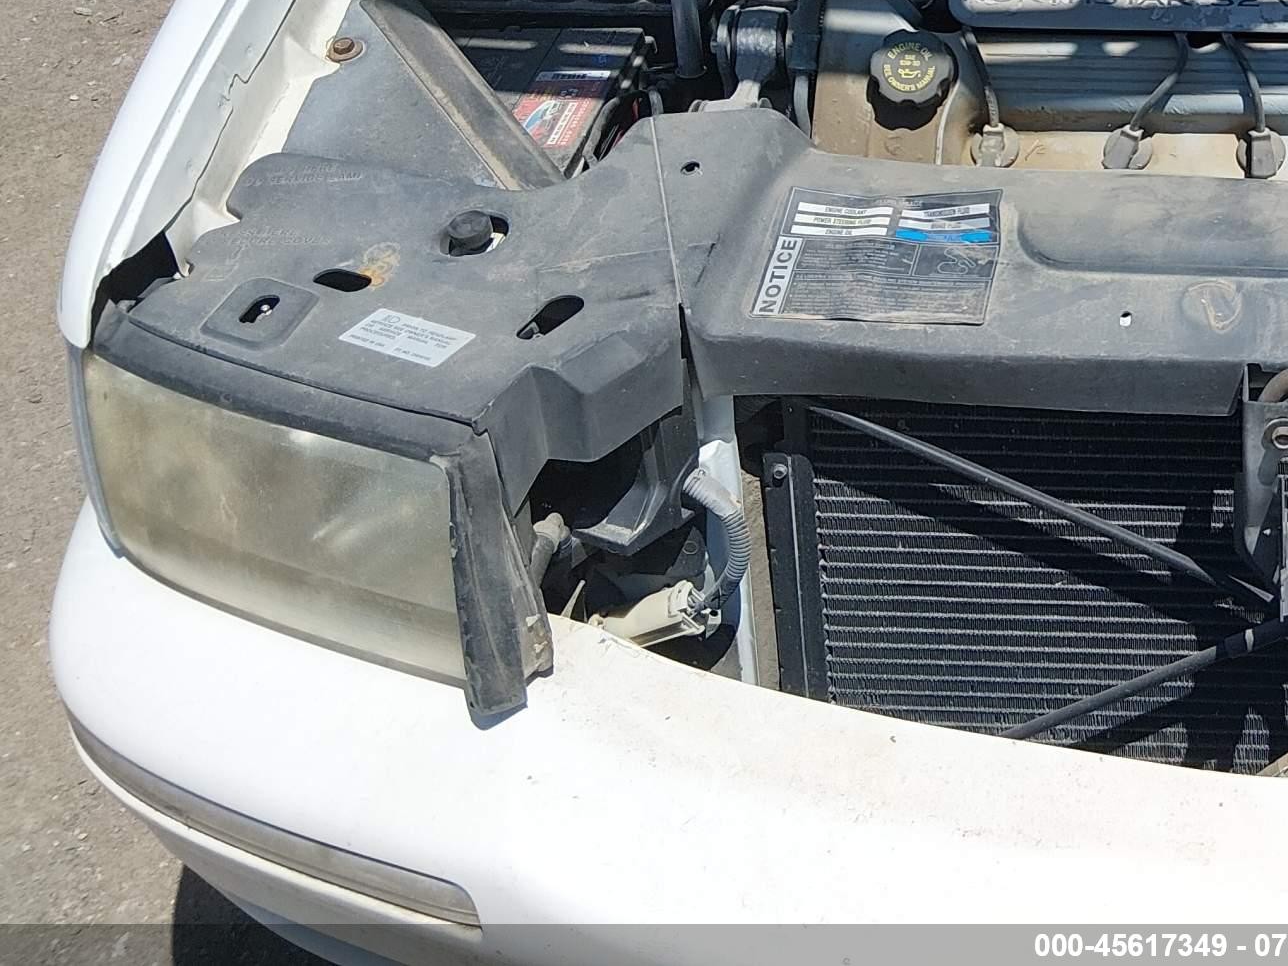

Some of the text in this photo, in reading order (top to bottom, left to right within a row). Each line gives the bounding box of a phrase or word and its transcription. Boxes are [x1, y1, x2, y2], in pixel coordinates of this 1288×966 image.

[887, 41, 933, 62] ENGINE OIL
[758, 237, 796, 314] NOTICE
